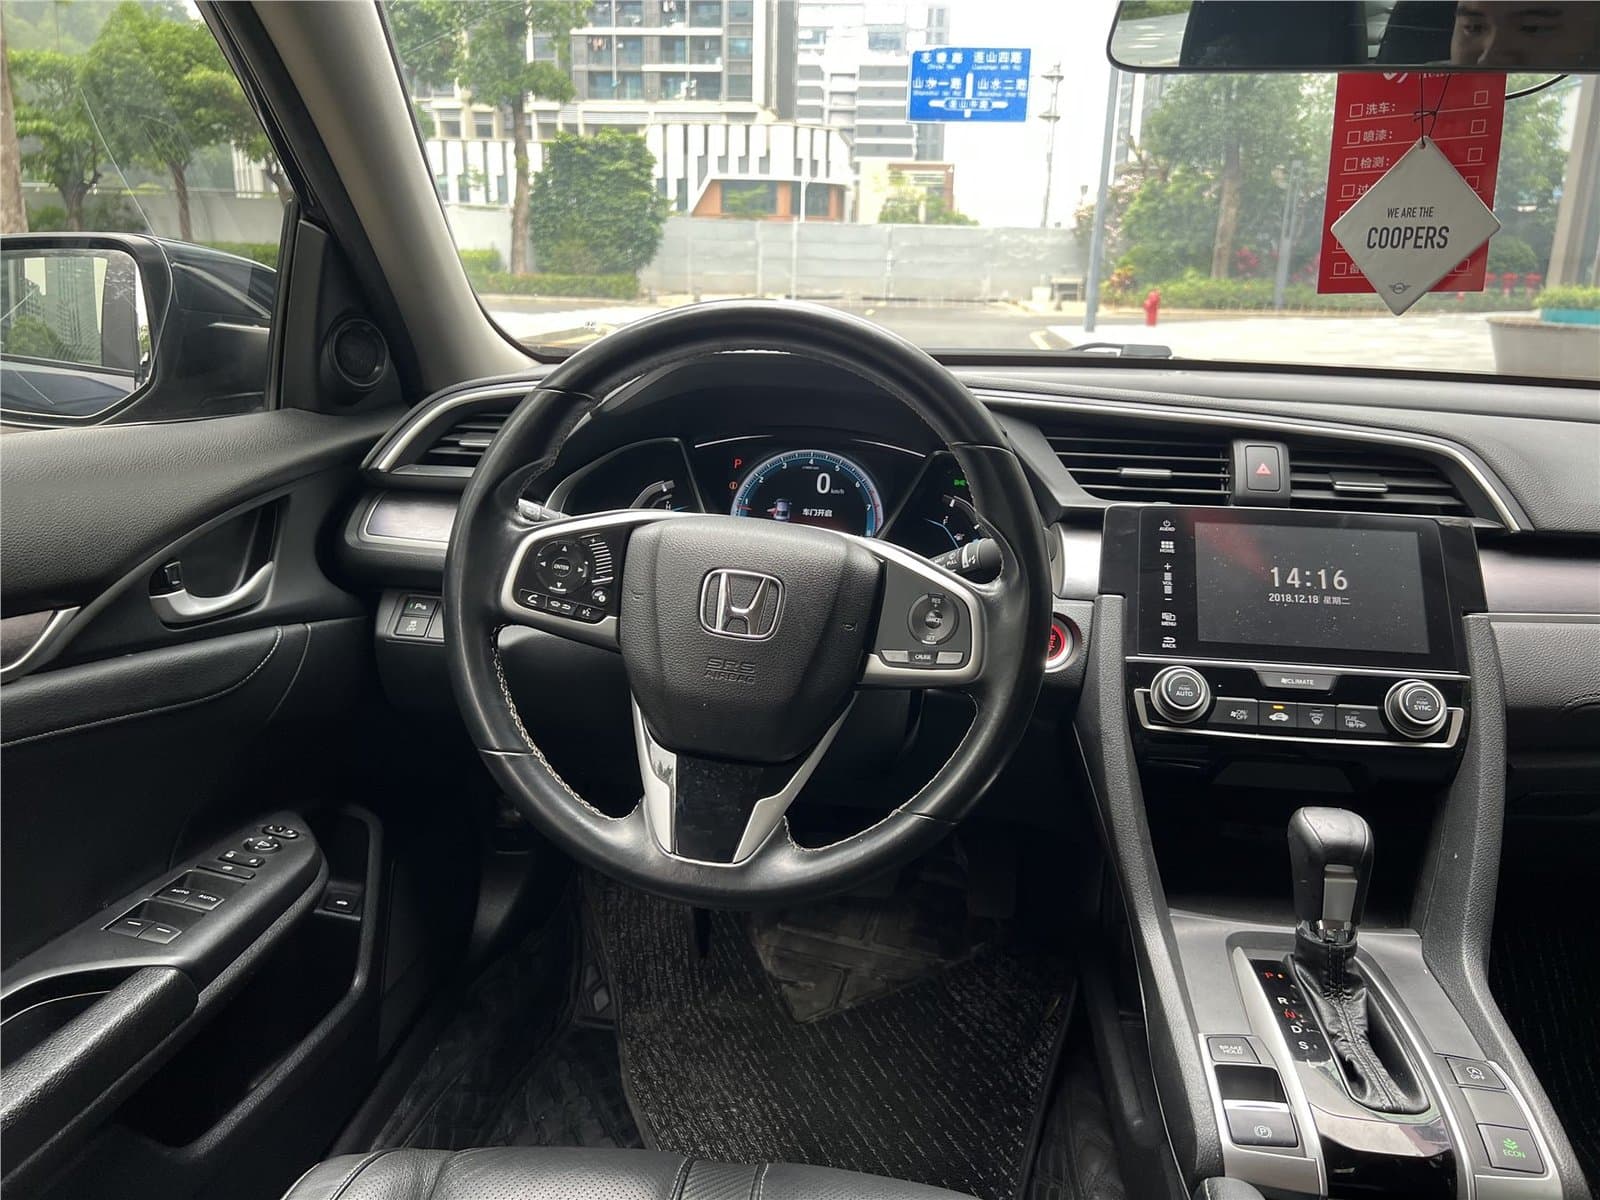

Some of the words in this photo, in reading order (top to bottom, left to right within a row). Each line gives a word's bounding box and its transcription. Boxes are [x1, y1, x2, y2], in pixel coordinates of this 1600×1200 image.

[1387, 207, 1400, 218] WE
[1400, 207, 1417, 218] ARE
[1419, 206, 1434, 217] THE
[1367, 226, 1450, 249] COOPERS
[734, 458, 743, 469] P
[816, 472, 831, 494] 0
[802, 508, 833, 517] 车门开启
[553, 563, 570, 571] ENTER
[1270, 566, 1348, 591] 14:16
[1268, 592, 1319, 604] 2018.12.18
[1287, 678, 1314, 686] CLIMATE
[1175, 690, 1194, 698] AUTO
[1413, 704, 1433, 712] SYNC
[198, 894, 217, 902] AUTO
[1290, 1024, 1302, 1034] D
[1298, 1041, 1309, 1050] S
[1503, 1149, 1526, 1159] ECON
